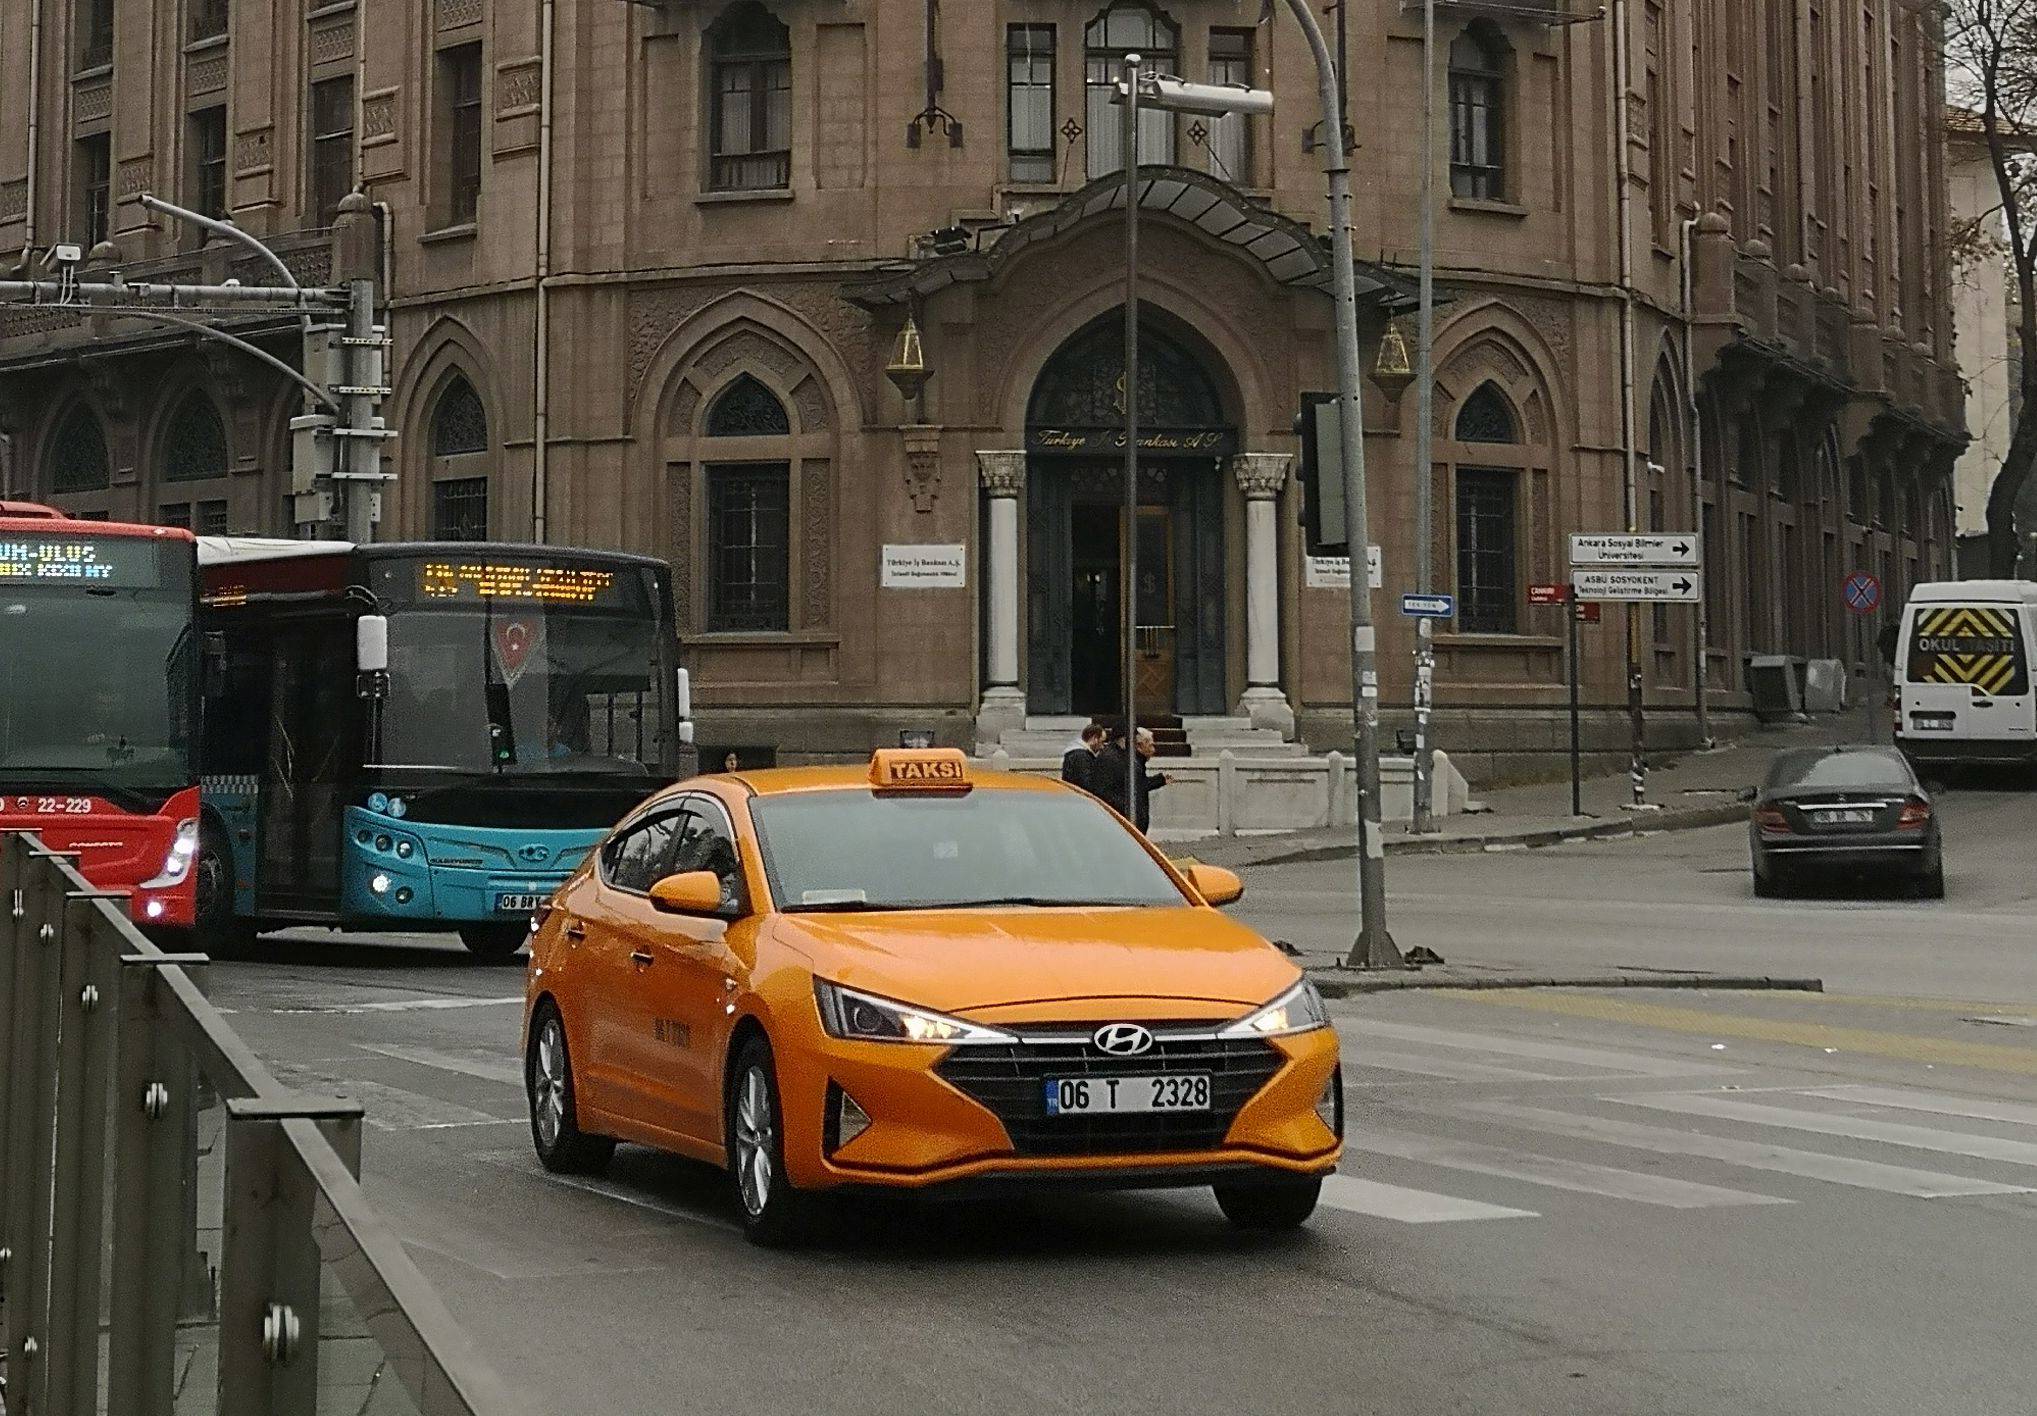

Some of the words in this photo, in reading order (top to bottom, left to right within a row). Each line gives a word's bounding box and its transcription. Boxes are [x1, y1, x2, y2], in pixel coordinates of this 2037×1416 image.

[1578, 538, 1606, 547] Ankara
[1608, 538, 1633, 550] Sosyal
[1919, 638, 1960, 652] OKUL
[37, 798, 92, 813] 22-229
[503, 895, 517, 908] 06
[1060, 1080, 1090, 1111] 06
[1105, 1079, 1120, 1109] T
[1151, 1077, 1209, 1108] 2328
